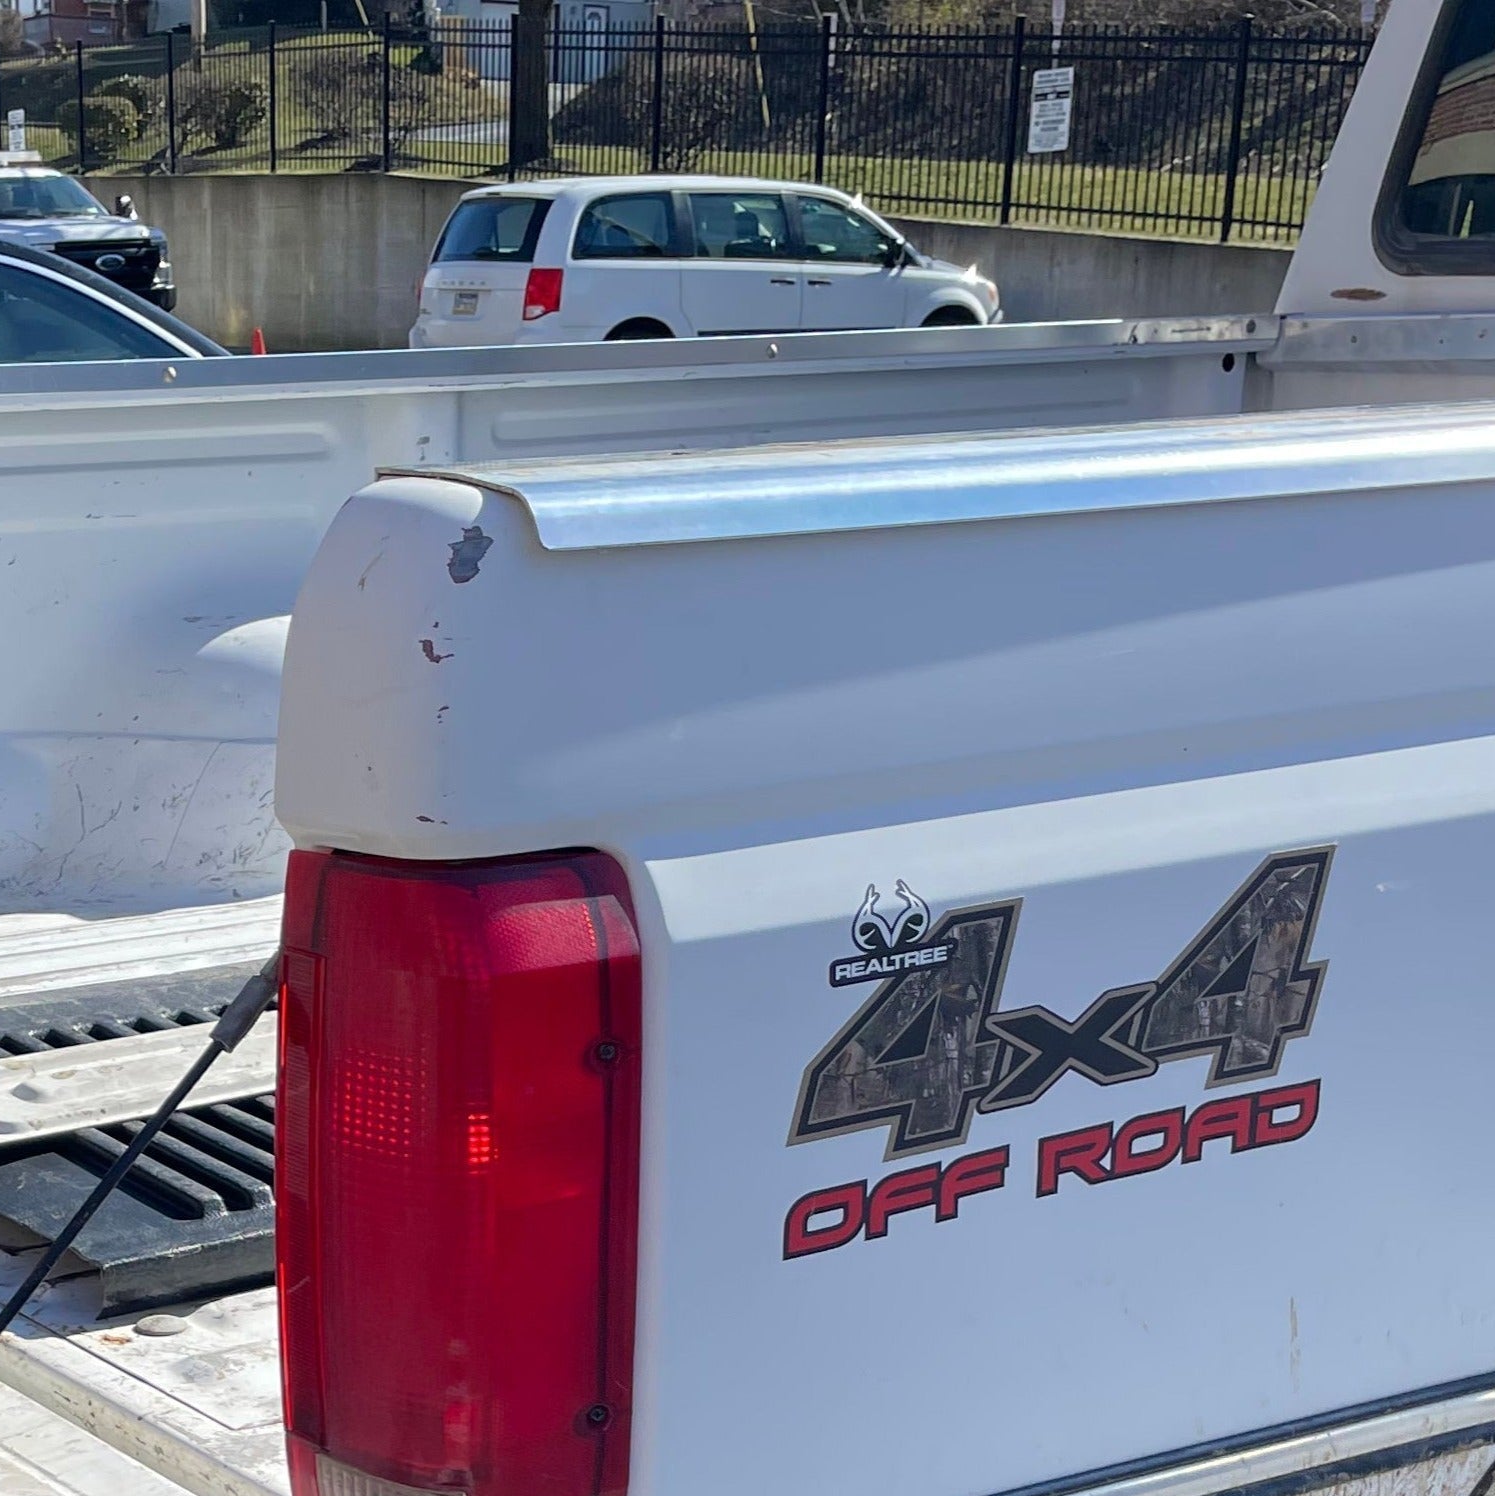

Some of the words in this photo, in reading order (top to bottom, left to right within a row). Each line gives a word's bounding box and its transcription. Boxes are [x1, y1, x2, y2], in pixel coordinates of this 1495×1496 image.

[835, 945, 947, 980] REALTREE
[783, 1144, 1011, 1260] OFF
[1036, 1079, 1321, 1198] ROAD
